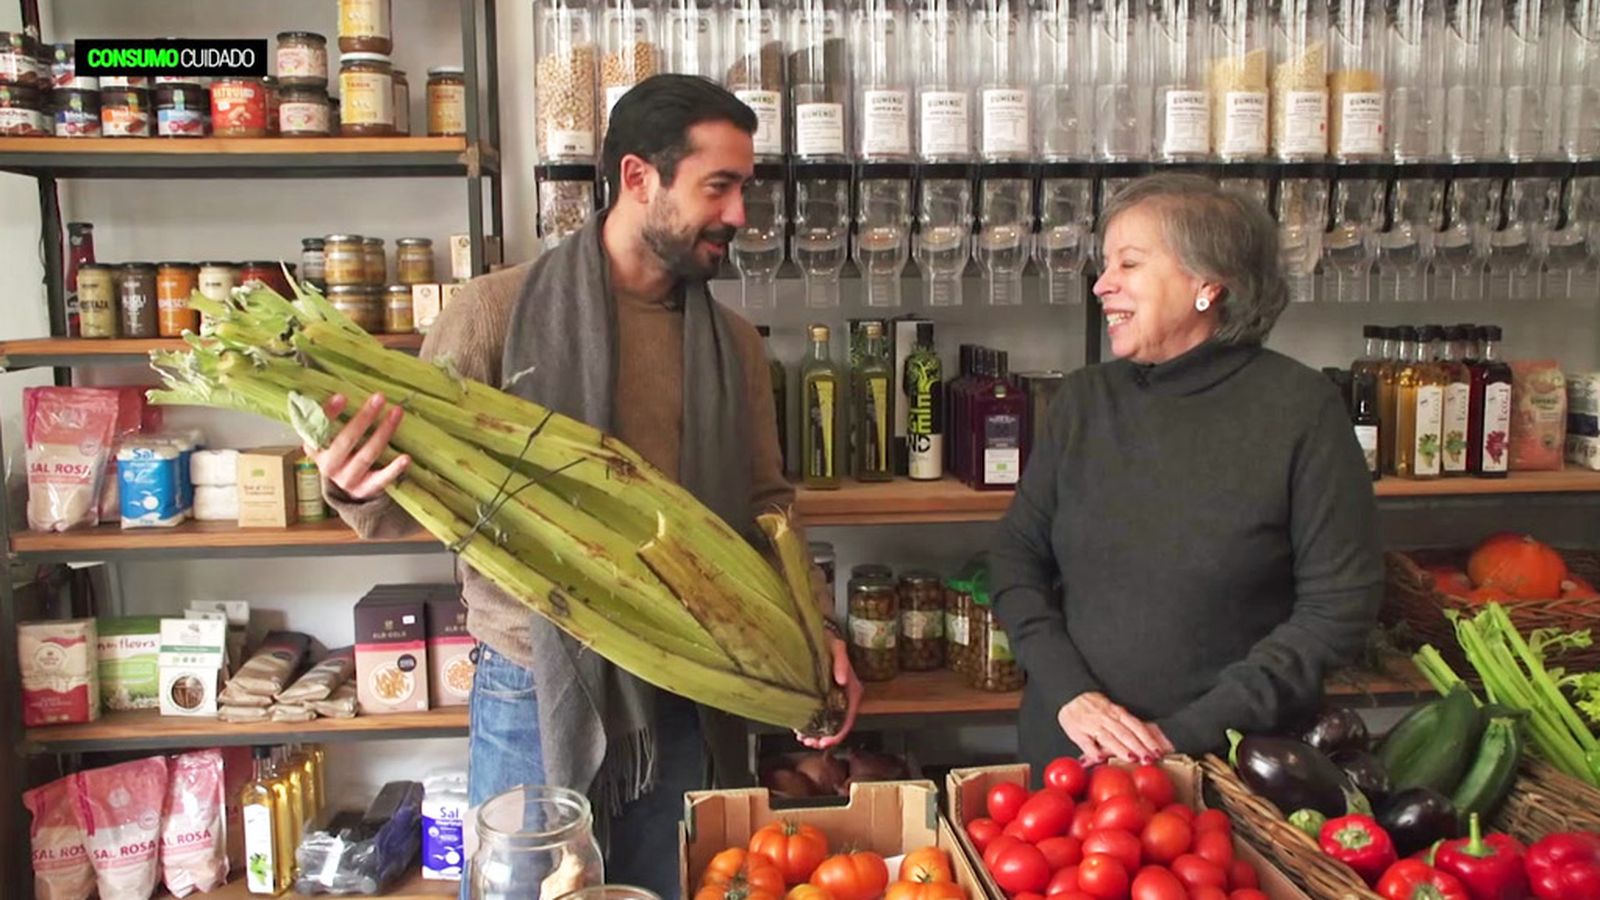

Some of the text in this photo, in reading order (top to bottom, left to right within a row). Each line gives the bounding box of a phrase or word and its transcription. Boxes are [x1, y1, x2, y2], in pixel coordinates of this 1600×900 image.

[31, 462, 92, 476] SAL ROSA
[439, 806, 460, 819] Sal
[177, 829, 212, 844] ROSA
[32, 843, 87, 861] SAL ROS
[120, 839, 157, 856] ROSA
